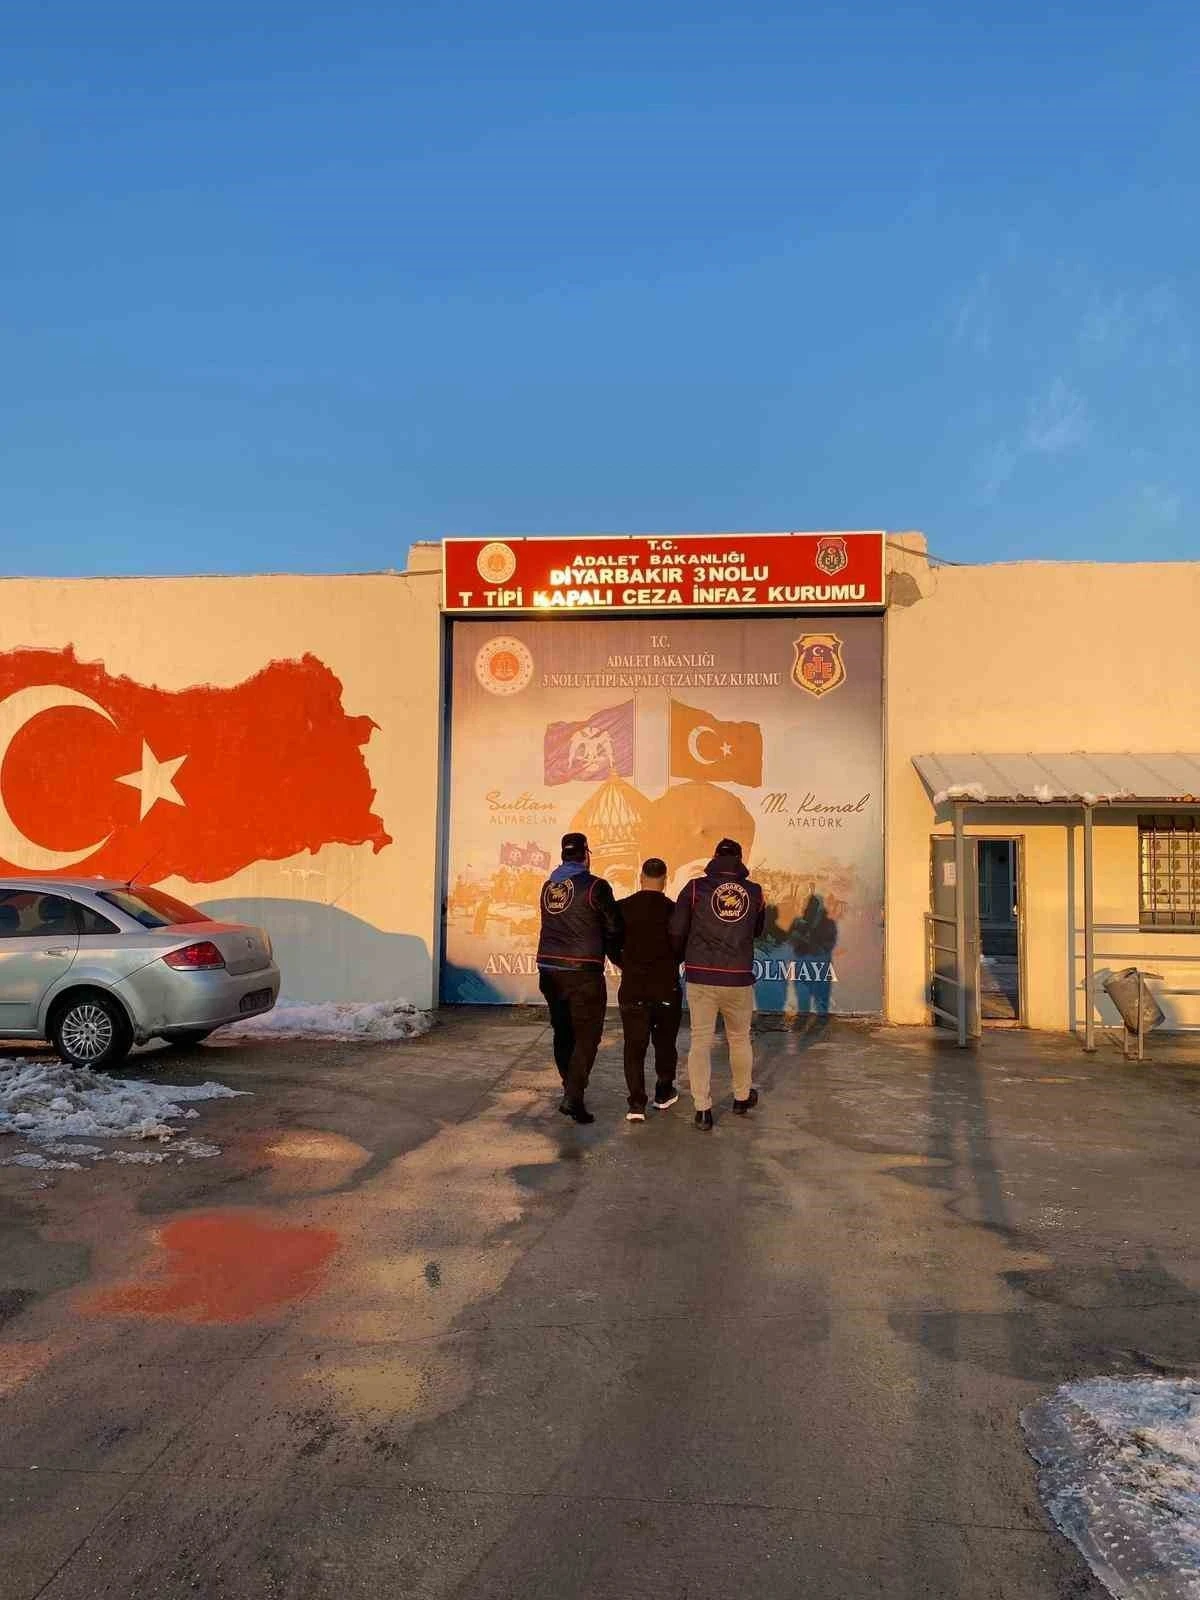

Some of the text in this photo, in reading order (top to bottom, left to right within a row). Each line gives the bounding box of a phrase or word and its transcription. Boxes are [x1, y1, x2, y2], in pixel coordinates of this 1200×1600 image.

[648, 540, 678, 550] T.C.
[573, 551, 745, 567] ADALET BAKANLIĞI
[550, 566, 683, 585] DİYARBAKIR
[459, 584, 866, 607] T TİPİ KAPALI CEZA İNFAZ KURUMU
[650, 635, 671, 648] T.C.
[607, 651, 715, 667] ADALET BAKANLIĞI
[730, 673, 782, 686] KURUMU
[486, 791, 556, 810] Sultan
[797, 791, 871, 814] Kemal
[788, 817, 843, 828] ATATÜRK
